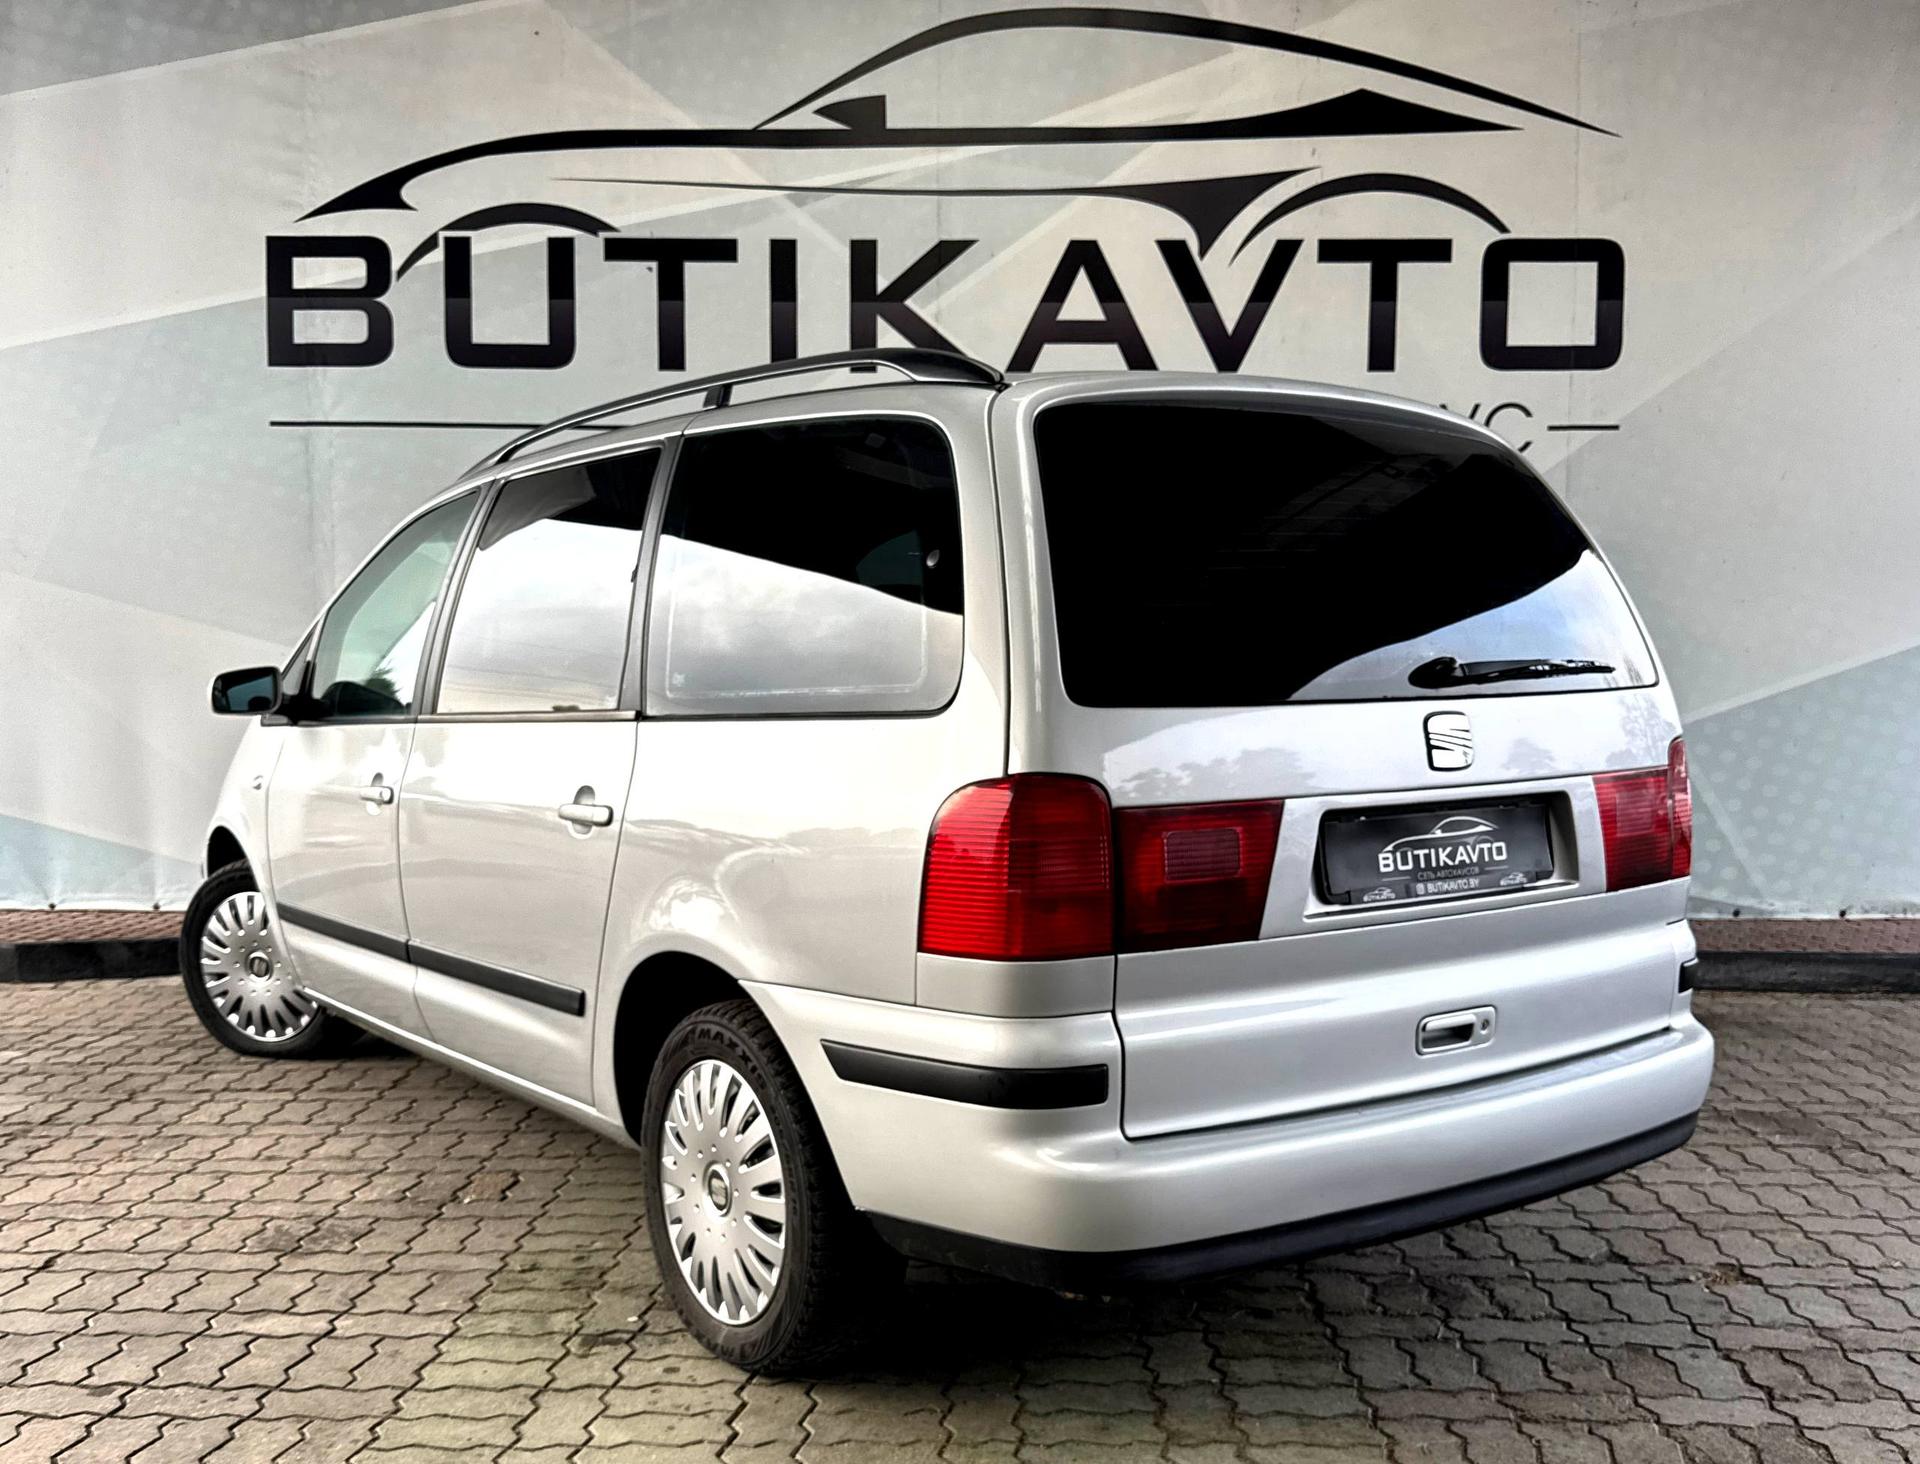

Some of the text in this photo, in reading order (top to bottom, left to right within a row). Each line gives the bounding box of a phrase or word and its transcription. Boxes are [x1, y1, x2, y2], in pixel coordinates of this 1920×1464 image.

[266, 235, 1625, 373] BUTIKAVTO
[1379, 841, 1507, 872] BUTIKAVTO
[1427, 878, 1480, 893] BUTIKAVTO.BY
